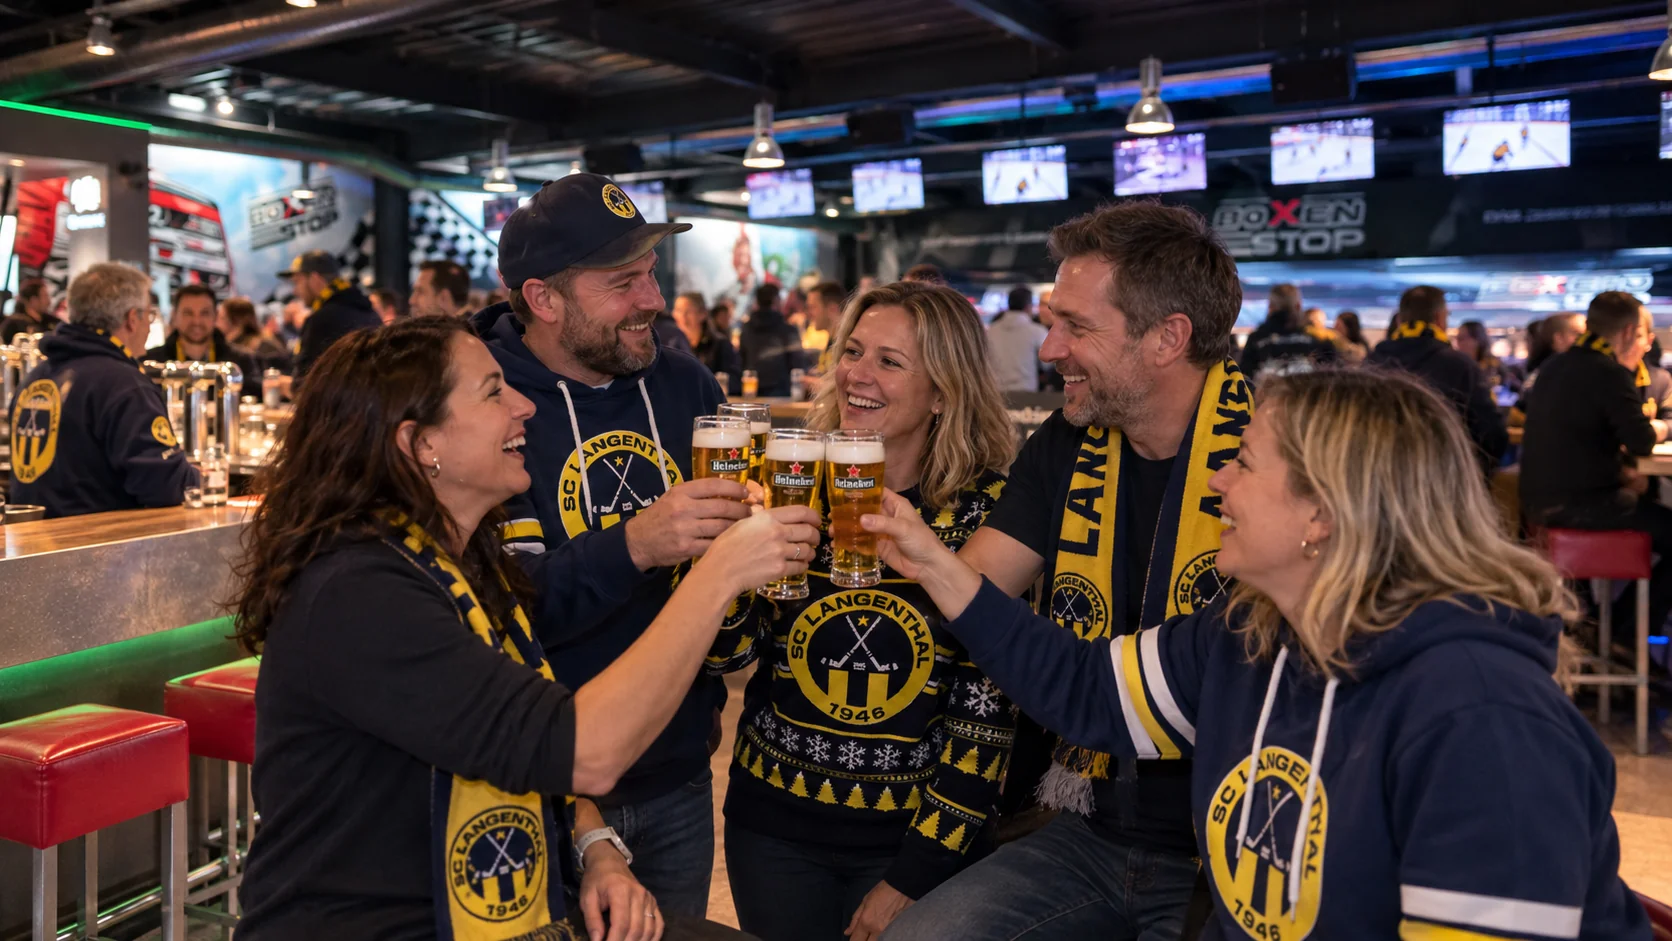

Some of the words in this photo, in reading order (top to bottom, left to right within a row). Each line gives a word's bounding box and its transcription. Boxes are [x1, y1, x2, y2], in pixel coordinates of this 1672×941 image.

[1212, 197, 1367, 231] BOXEN
[1247, 228, 1366, 257] STOP
[563, 479, 576, 511] SC
[1053, 576, 1104, 625] ANGENTHAL
[1180, 583, 1190, 604] SC
[791, 629, 808, 660] SC
[804, 593, 930, 669] LANGENTHAL
[829, 702, 885, 722] 1946
[1212, 785, 1237, 825] SC
[453, 860, 466, 887] SC
[486, 895, 529, 917] 1946
[1234, 898, 1281, 940] 1946
